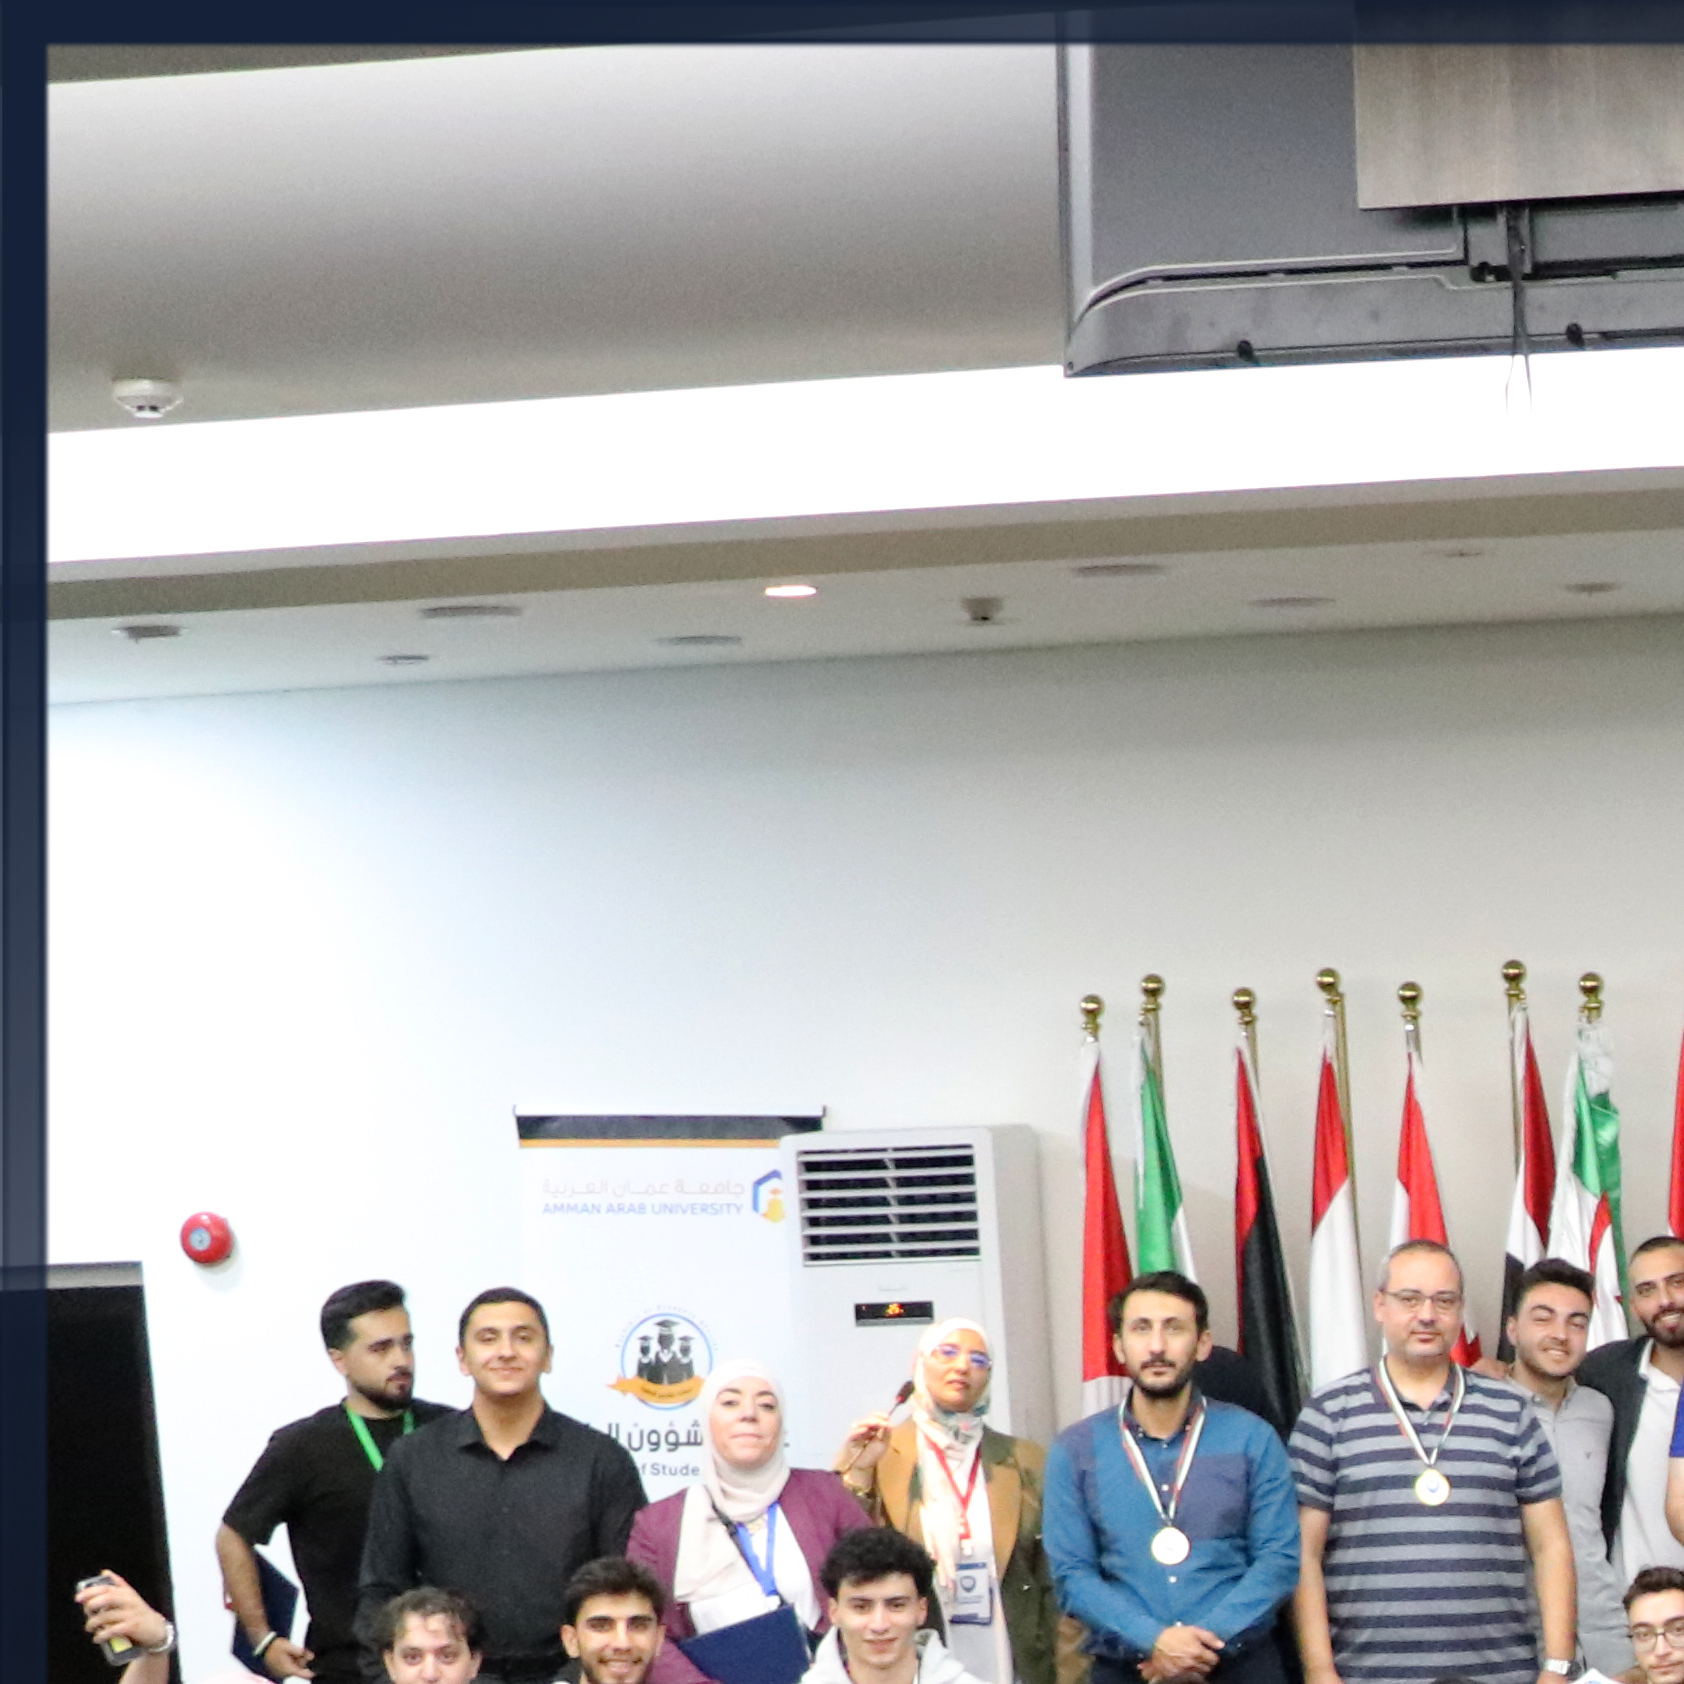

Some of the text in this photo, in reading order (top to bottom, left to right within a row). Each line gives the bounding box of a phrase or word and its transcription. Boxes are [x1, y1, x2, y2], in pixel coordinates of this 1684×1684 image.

[542, 1203, 744, 1216] AMMAN ARAB UNIVERSITY
